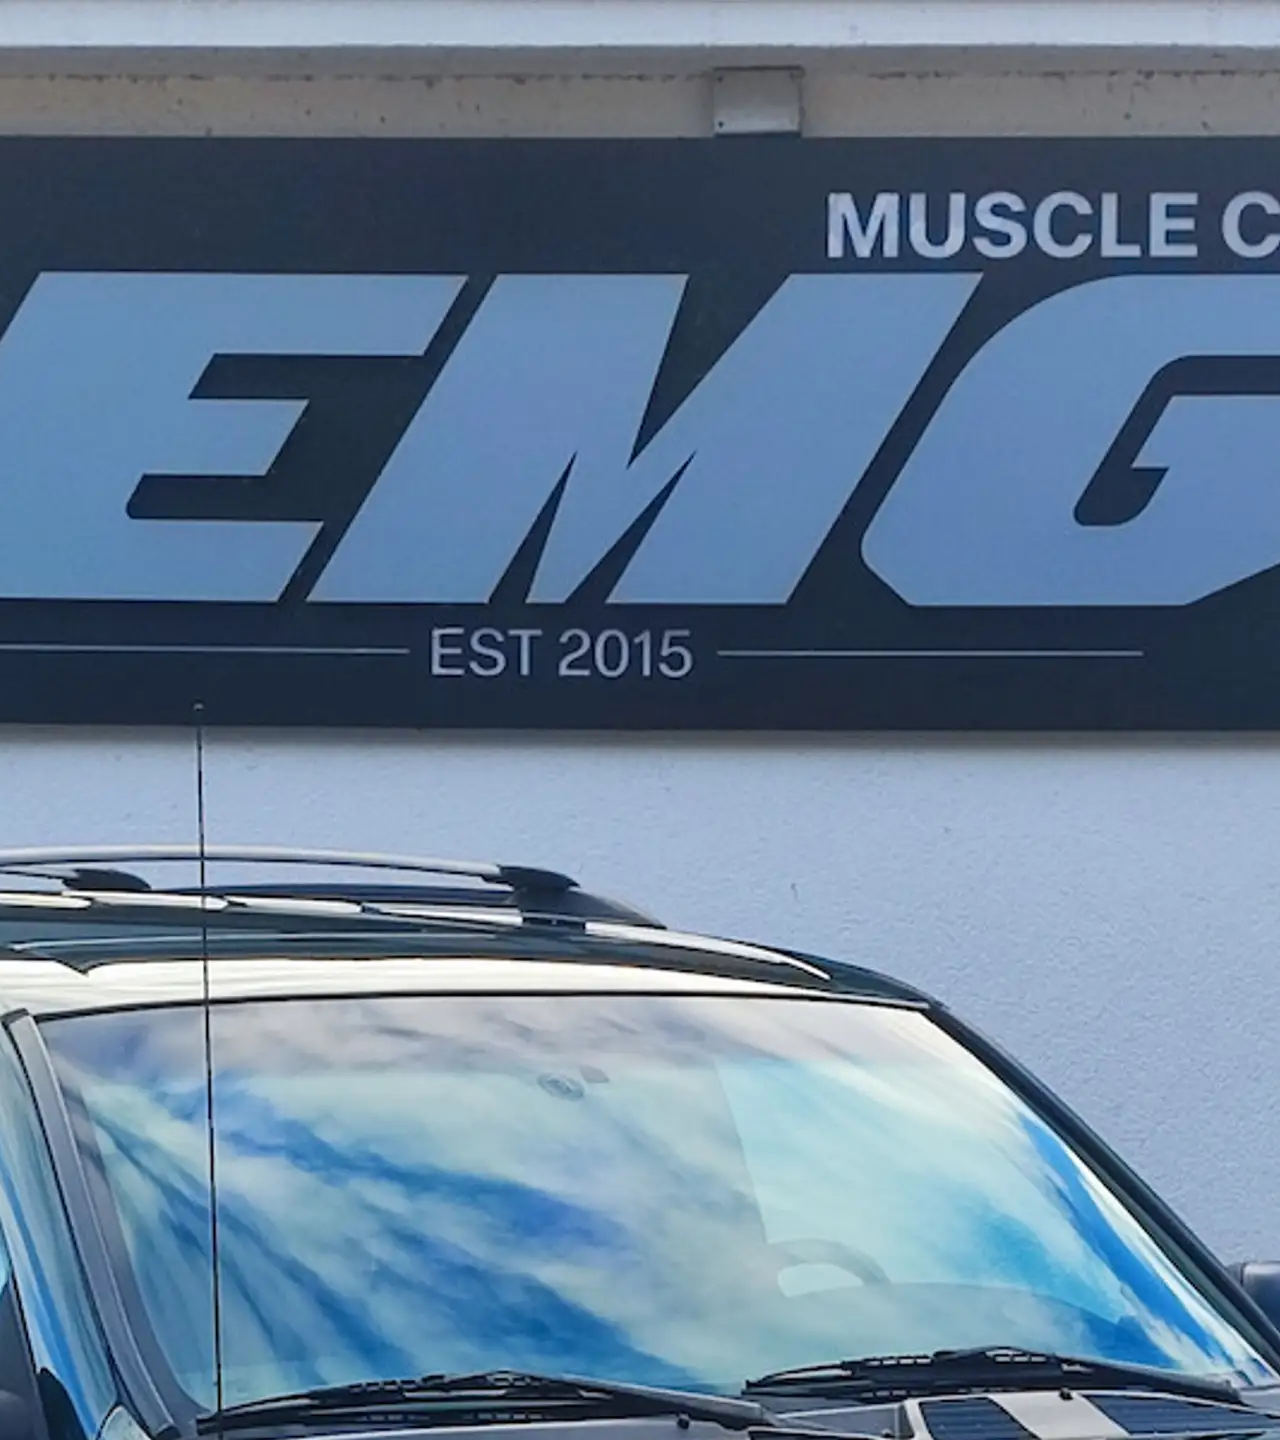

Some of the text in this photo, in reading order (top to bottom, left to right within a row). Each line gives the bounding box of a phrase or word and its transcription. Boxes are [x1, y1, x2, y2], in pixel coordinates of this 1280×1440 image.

[826, 191, 1199, 259] MUSCLE
[430, 626, 694, 678] EST 2015
